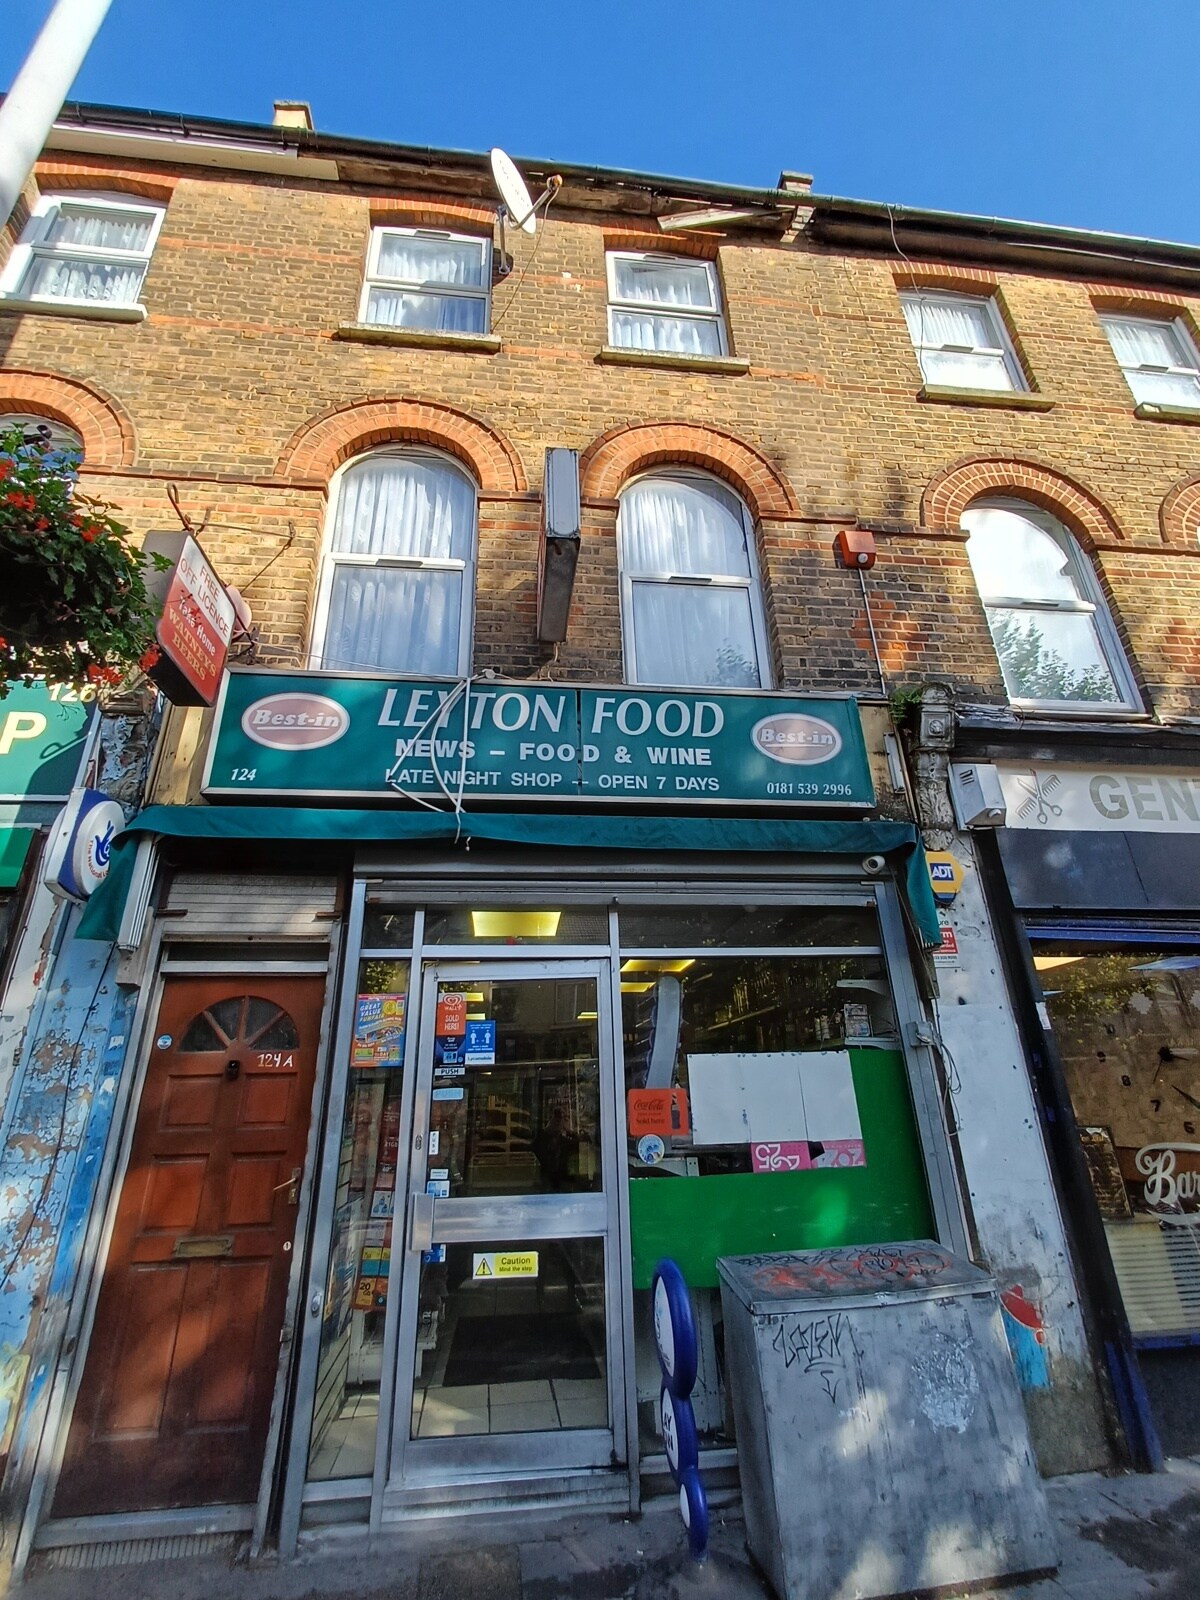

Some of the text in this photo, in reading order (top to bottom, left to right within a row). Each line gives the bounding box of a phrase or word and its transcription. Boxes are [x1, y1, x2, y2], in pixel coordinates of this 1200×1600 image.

[200, 566, 220, 599] FREE
[180, 558, 229, 638] OFF LICENCE
[196, 622, 216, 657] Home
[172, 632, 207, 682] BEERS
[49, 682, 97, 703] 126
[252, 708, 340, 728] Best-in
[377, 688, 724, 738] LEYTON FOOD
[760, 728, 834, 746] Best-in
[395, 738, 476, 759] NEWS
[519, 743, 600, 764] FOOD
[614, 745, 632, 764] &
[647, 746, 712, 766] WINE
[230, 768, 257, 781] 124
[385, 768, 434, 784] LATE
[443, 769, 501, 786] NIGHT
[511, 773, 562, 788] SHOP
[598, 774, 648, 789] OPEN
[656, 776, 666, 789] 7
[675, 777, 720, 791] DAYS
[766, 782, 852, 796] 0181 539 2996
[1089, 774, 1200, 821] GEN
[931, 865, 954, 878] ADT
[360, 1002, 381, 1011] GREAT
[361, 1008, 382, 1017] VALUE
[445, 1014, 460, 1022] SOLD
[501, 1257, 531, 1265] Caution
[359, 1282, 371, 1291] 20
